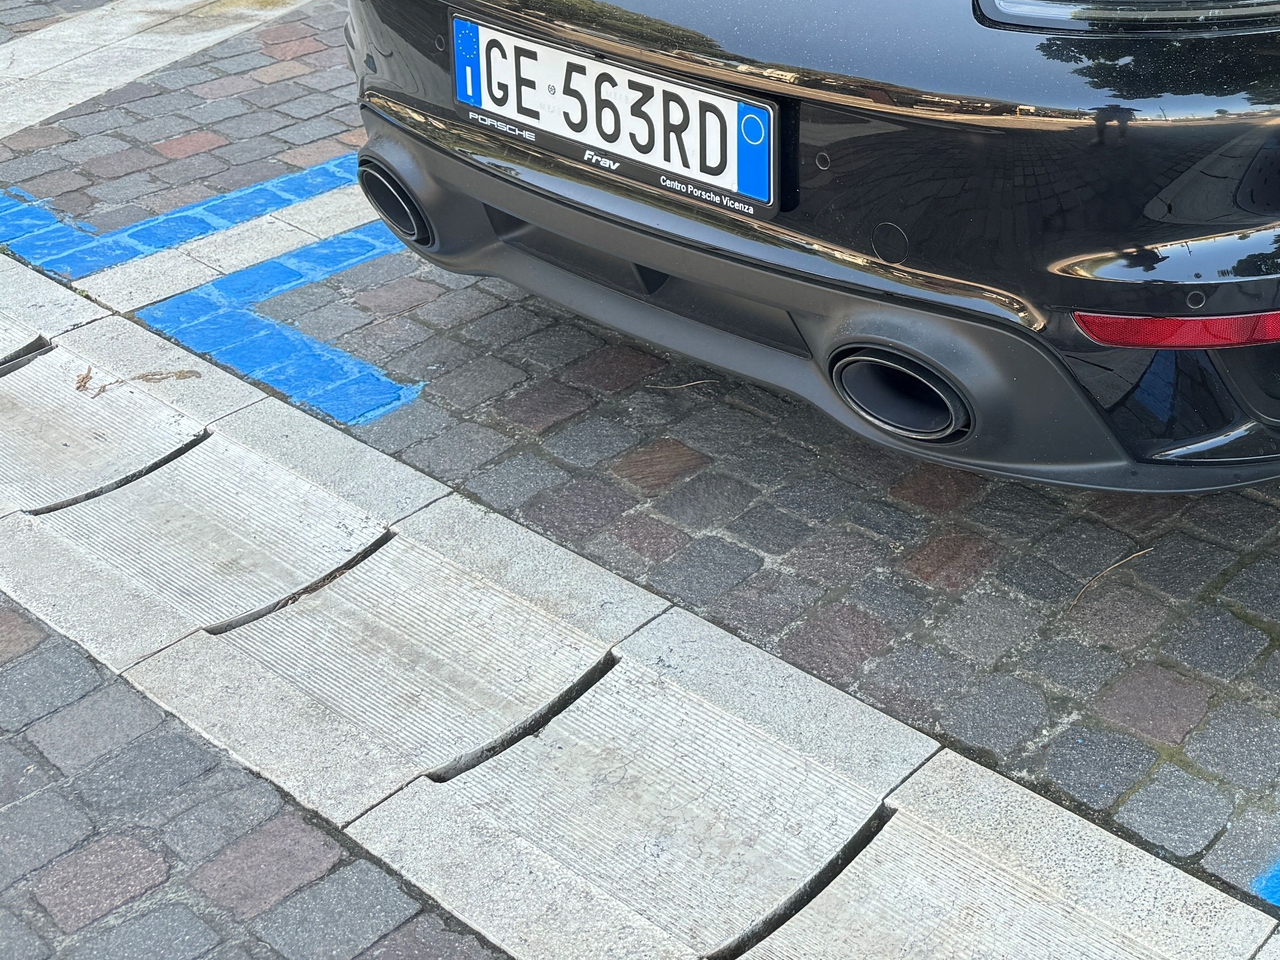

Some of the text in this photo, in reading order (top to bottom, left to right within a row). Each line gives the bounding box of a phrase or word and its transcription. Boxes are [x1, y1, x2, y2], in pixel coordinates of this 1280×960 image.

[485, 38, 541, 121] GE
[562, 60, 728, 177] 563RD
[468, 111, 536, 142] PORSCHE
[583, 150, 621, 171] Frav
[660, 175, 754, 215] Centro Porsche Vicenza
